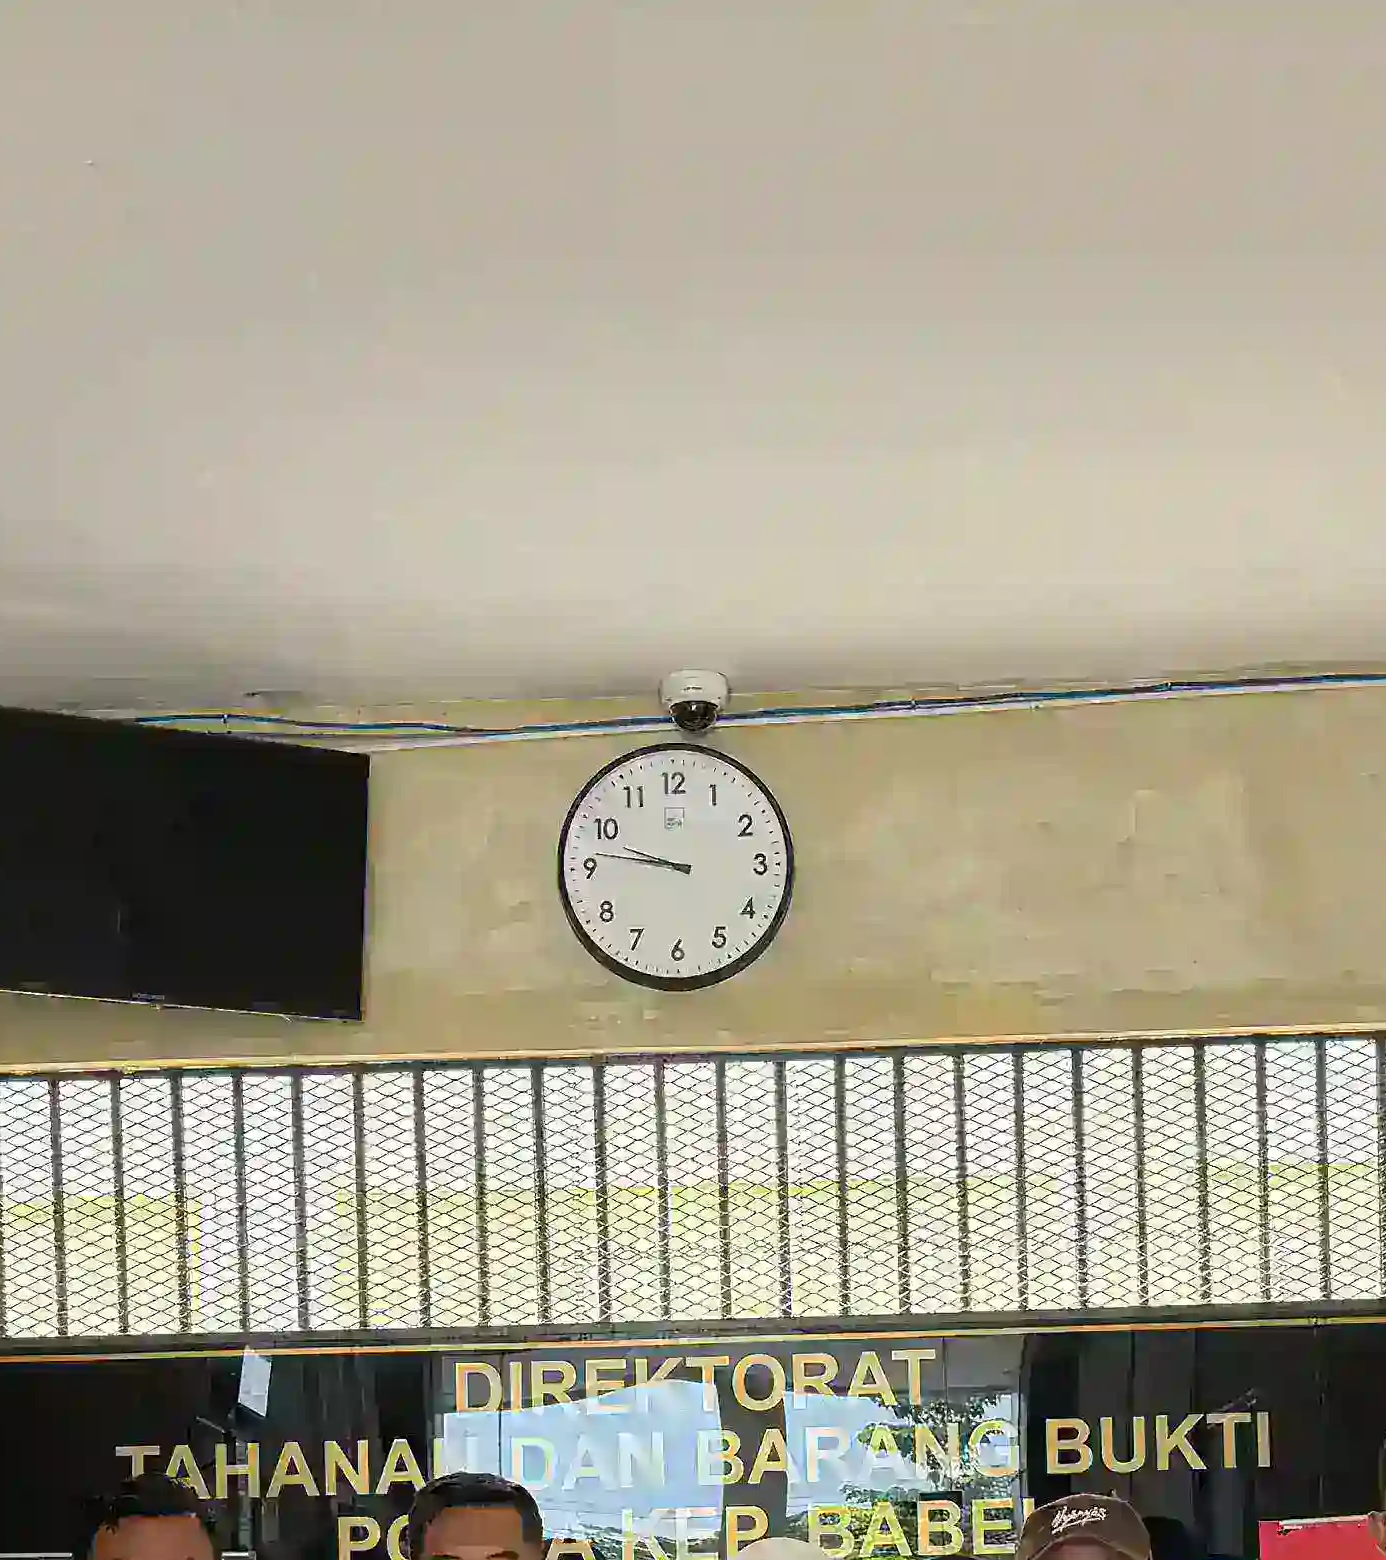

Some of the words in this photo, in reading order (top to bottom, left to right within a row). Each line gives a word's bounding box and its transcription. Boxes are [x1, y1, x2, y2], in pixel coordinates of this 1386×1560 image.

[661, 772, 686, 794] 12
[622, 785, 644, 808] 11
[709, 784, 717, 806] 1
[594, 818, 619, 840] 10
[737, 814, 754, 837] 2
[583, 857, 597, 879] 9
[753, 853, 768, 875] 3
[599, 900, 614, 923] 8
[739, 896, 755, 919] 4
[629, 928, 645, 951] 7
[711, 926, 727, 949] 5
[670, 938, 685, 961] 6
[455, 1348, 936, 1414] DIREKTORAT
[509, 1430, 665, 1493] DAN
[697, 1420, 1020, 1486] BARANG
[1046, 1411, 1271, 1475] BUKTI
[810, 1496, 1039, 1560] BABE
